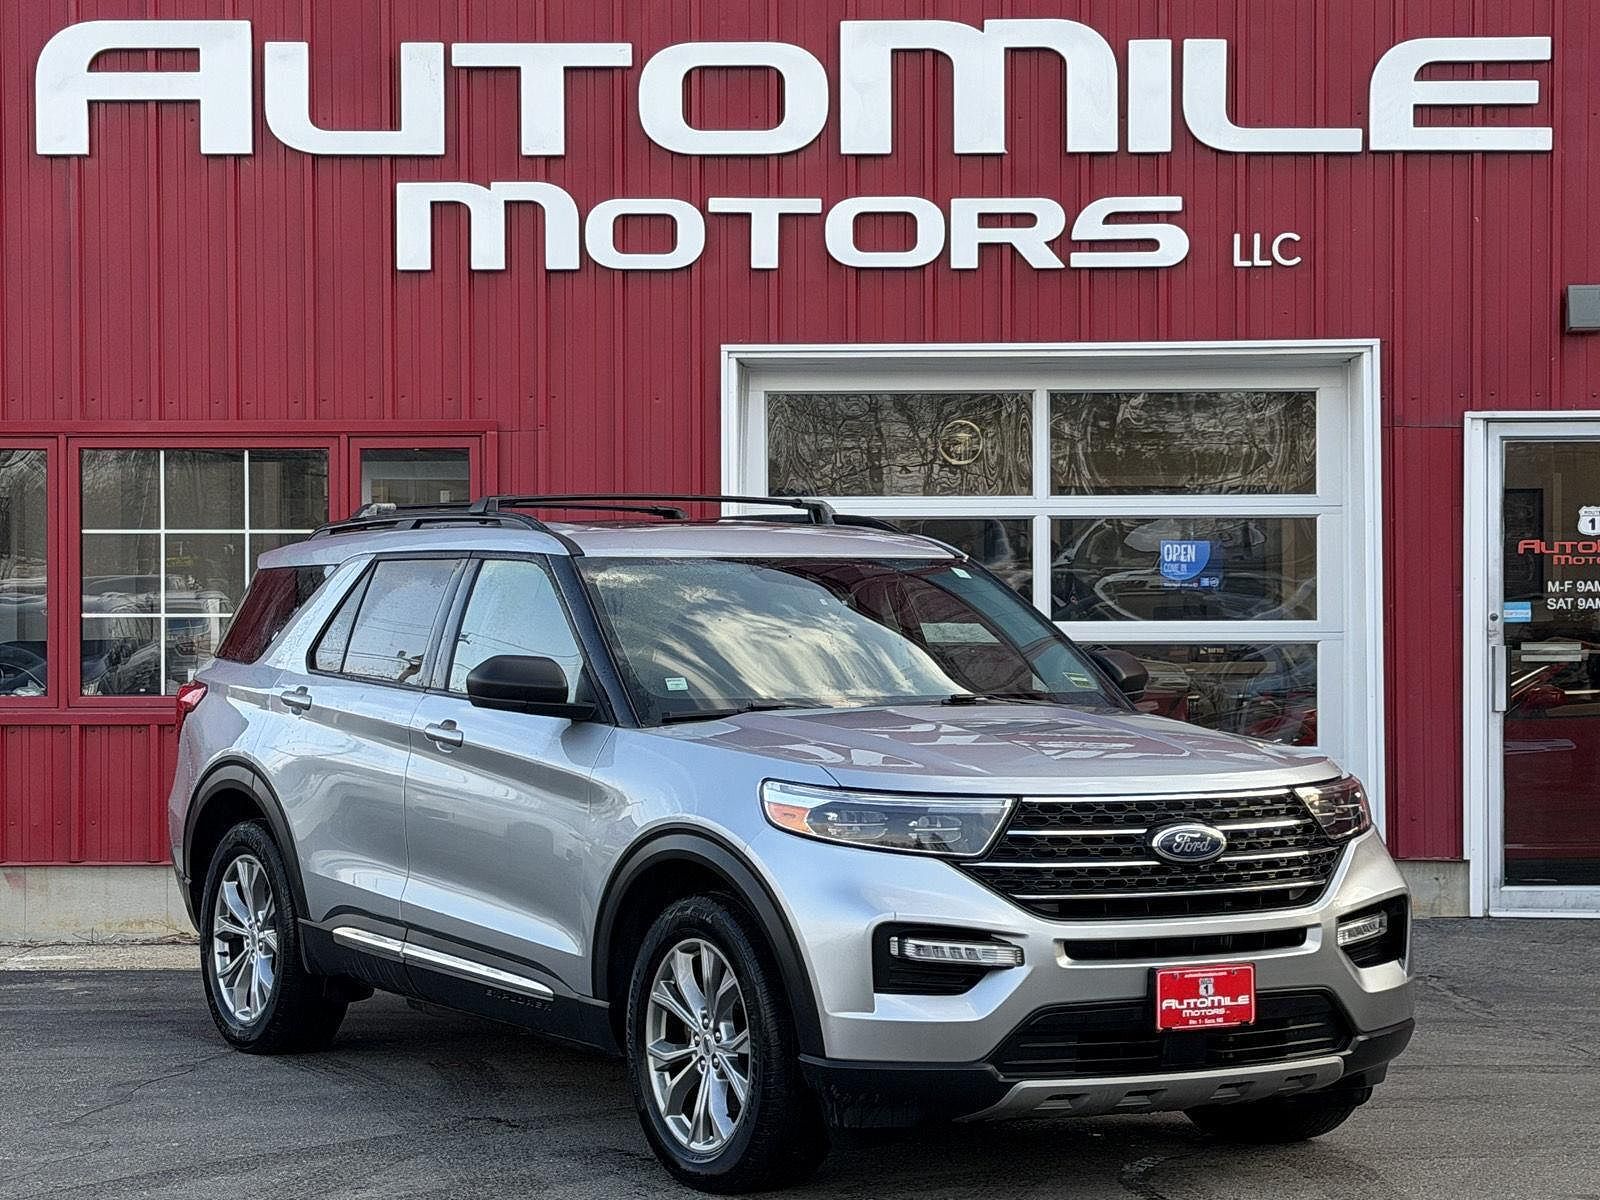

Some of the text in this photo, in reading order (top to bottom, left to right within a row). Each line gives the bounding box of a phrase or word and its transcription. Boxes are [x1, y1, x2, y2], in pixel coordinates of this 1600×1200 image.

[35, 18, 1553, 156] AUTOMILE
[395, 181, 1302, 271] MOTORS LLC
[1588, 517, 1596, 531] 1
[1164, 544, 1196, 562] OPEN
[1518, 540, 1600, 554] AUTO
[1553, 555, 1600, 565] MOT
[1547, 580, 1573, 593] M-F
[1546, 597, 1574, 610] SAT
[1172, 832, 1212, 853] Ford
[1162, 995, 1249, 1010] AUTOMILE
[1182, 1007, 1225, 1018] MOTORS
